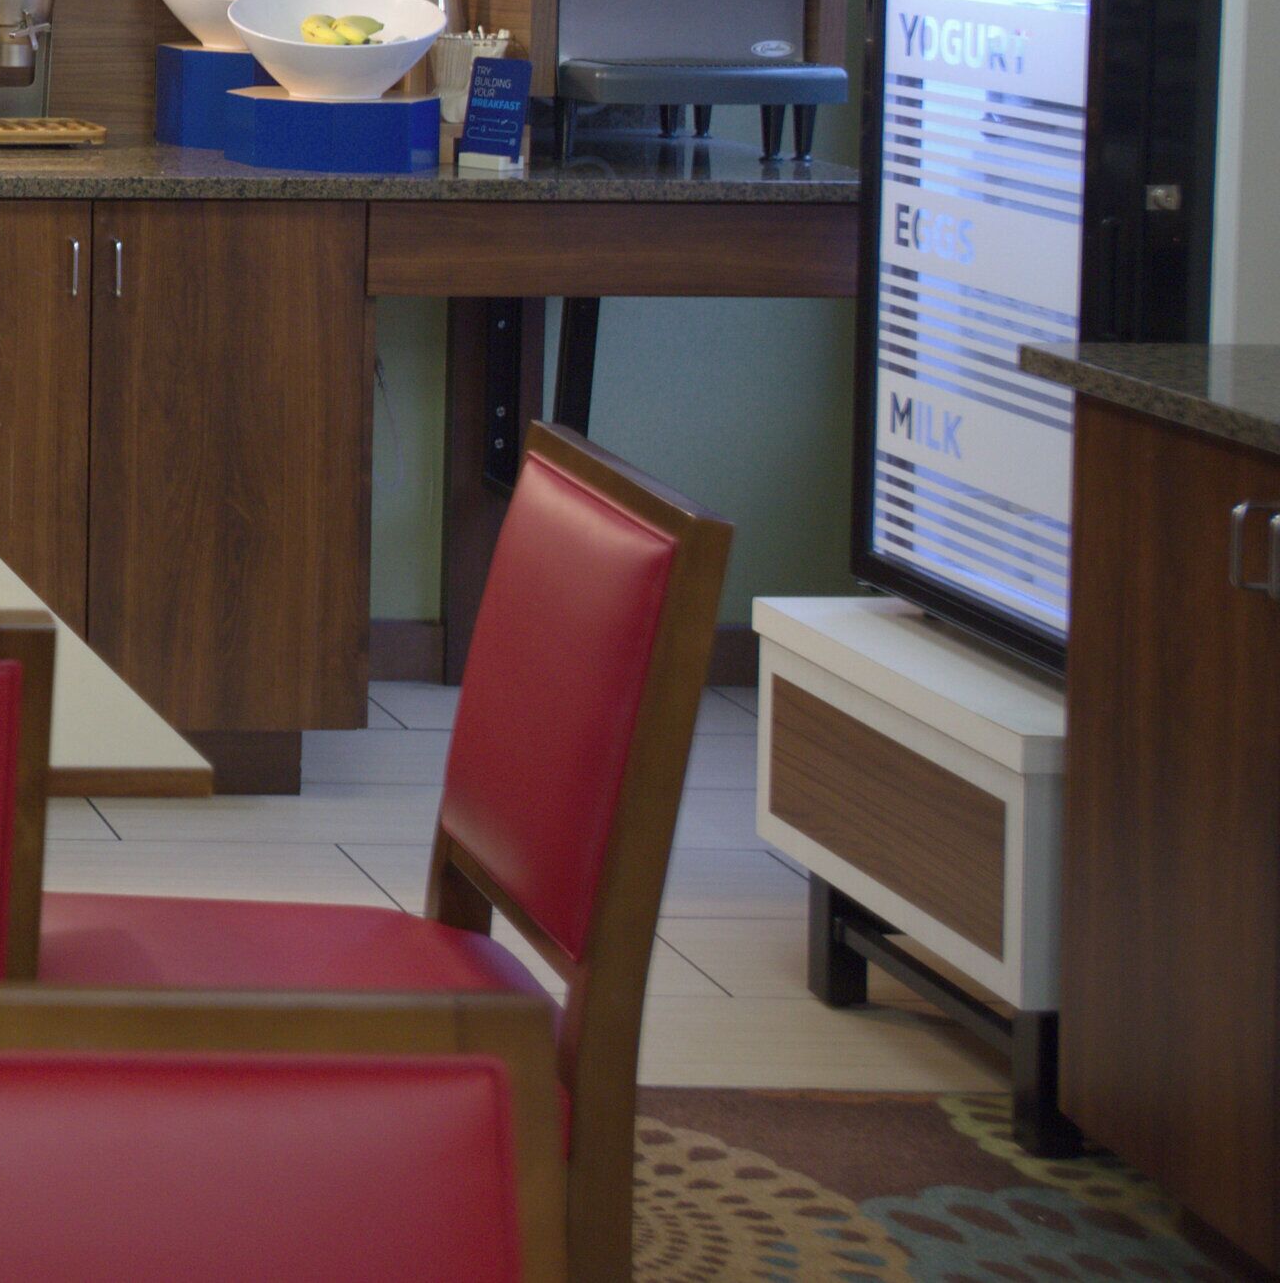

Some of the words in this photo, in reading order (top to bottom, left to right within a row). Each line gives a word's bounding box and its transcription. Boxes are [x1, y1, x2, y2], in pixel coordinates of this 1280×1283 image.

[898, 12, 1029, 75] YOGURT
[477, 65, 491, 75] TRY
[474, 76, 512, 89] BUILDING
[474, 87, 495, 98] YOUR
[472, 98, 520, 110] BREAKFAST
[894, 202, 976, 266] EGGS
[890, 391, 963, 459] MILK
